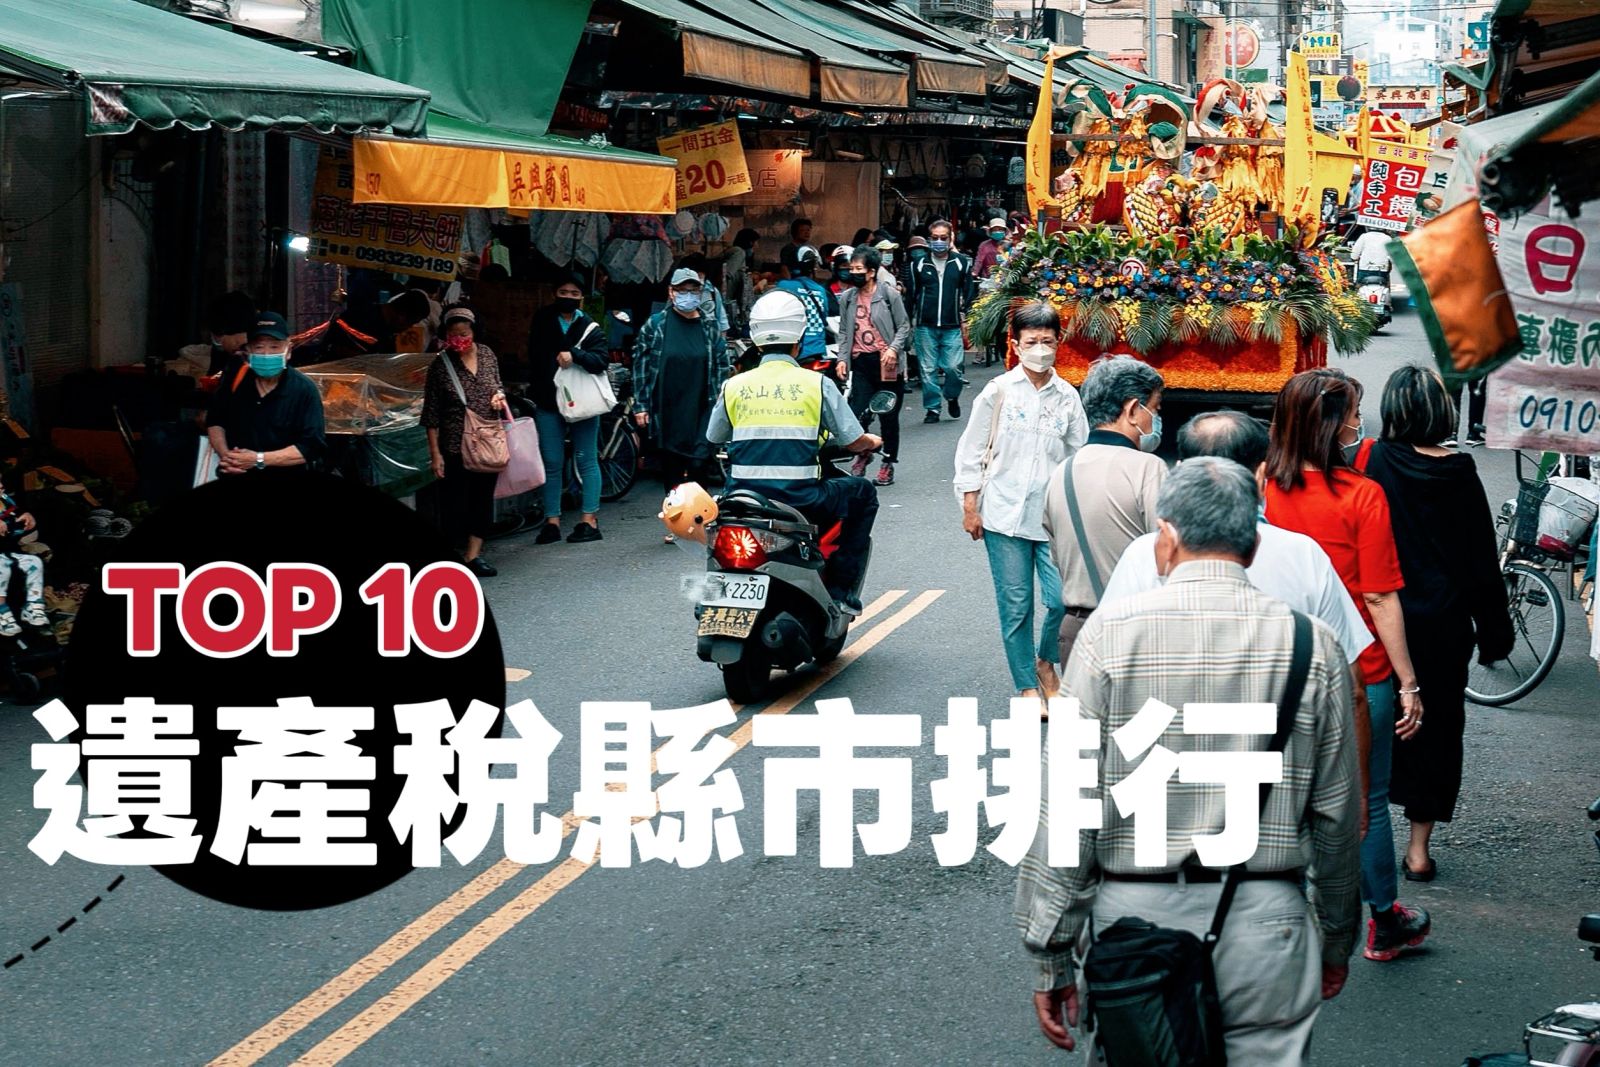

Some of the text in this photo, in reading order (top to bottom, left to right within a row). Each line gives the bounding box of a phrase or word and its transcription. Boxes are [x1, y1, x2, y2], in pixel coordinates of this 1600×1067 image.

[665, 127, 735, 152] 一間五金
[685, 160, 726, 195] 20
[1364, 161, 1388, 216] 純手工
[355, 245, 455, 274] 0983239189
[739, 383, 804, 401] 松山義警
